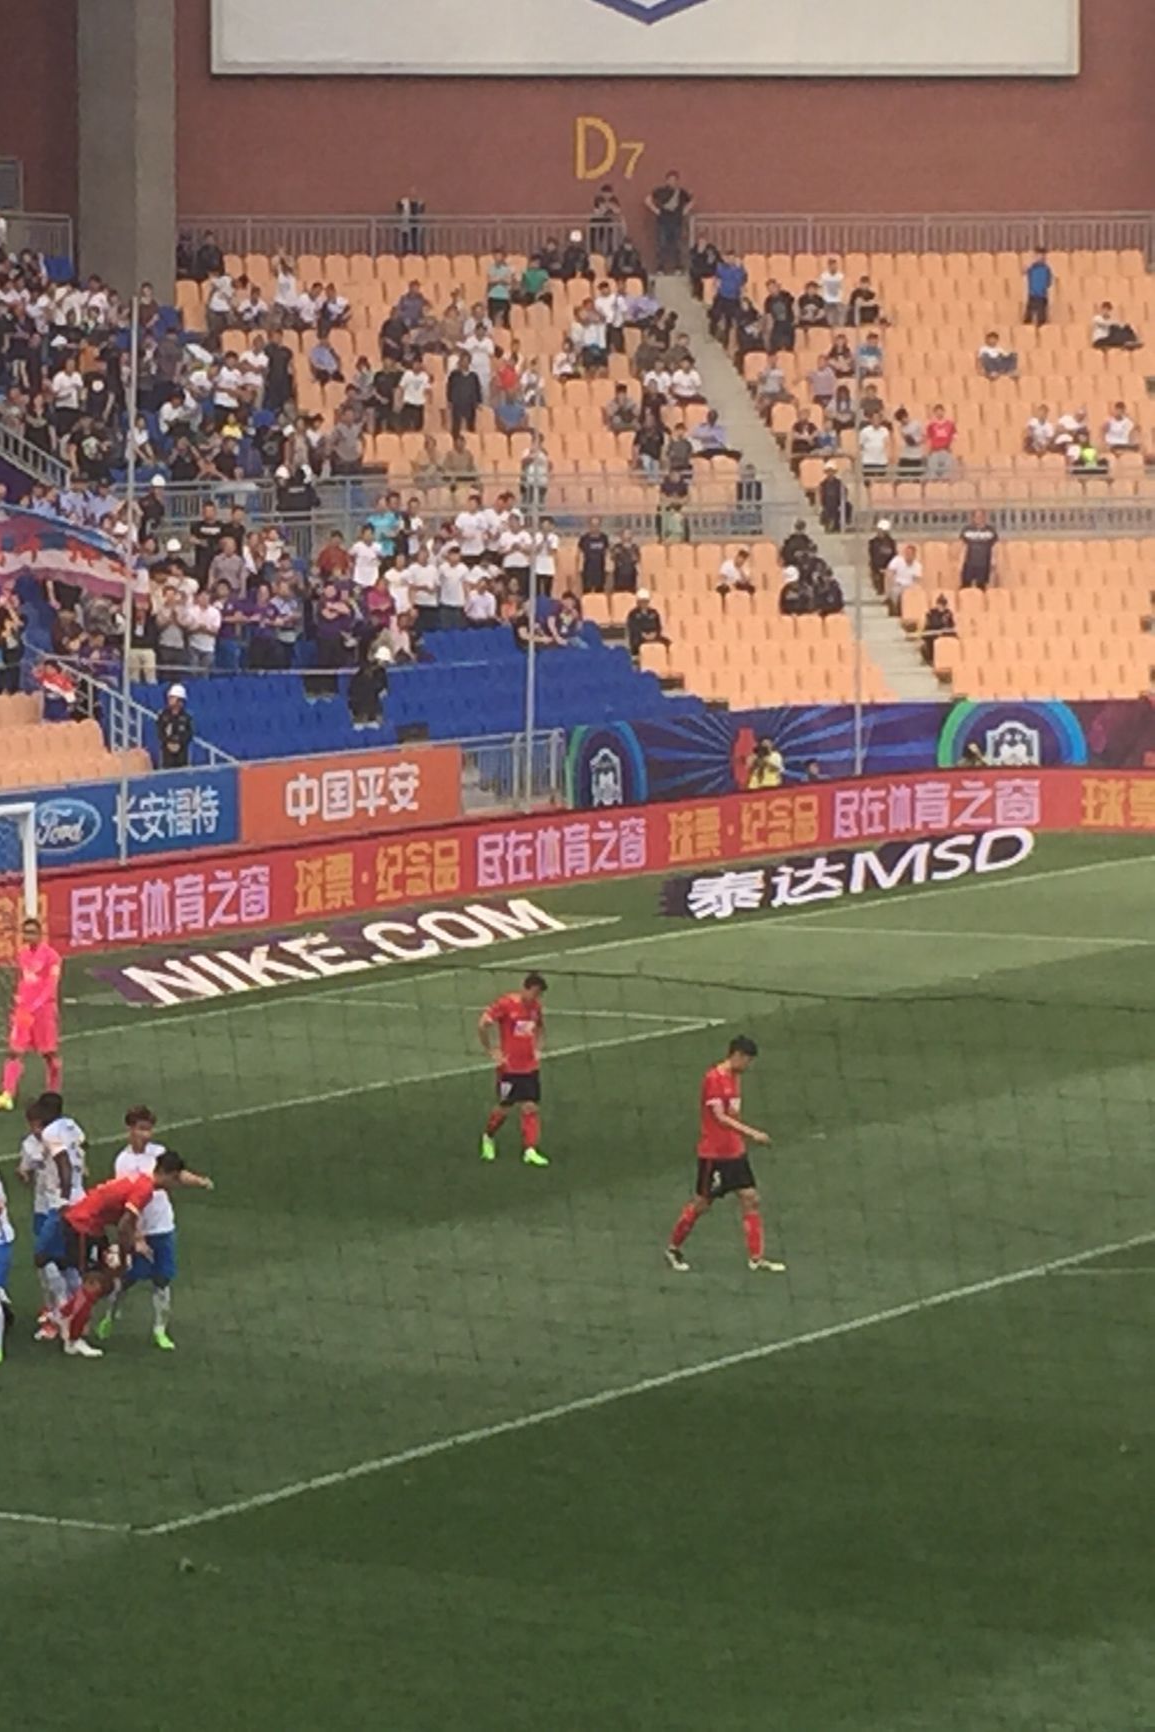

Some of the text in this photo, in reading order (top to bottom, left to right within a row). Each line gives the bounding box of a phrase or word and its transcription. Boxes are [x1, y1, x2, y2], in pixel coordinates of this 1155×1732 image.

[575, 116, 645, 180] D7
[112, 785, 220, 846] 长安福特
[285, 762, 421, 826] 中国平安
[833, 778, 1040, 839] 尽在体育之窗
[36, 808, 86, 845] Ford
[477, 816, 646, 888] 尽在体育之窗
[687, 827, 1035, 919] 泰达MSD
[70, 865, 271, 947] 尽在体育之窗
[122, 899, 566, 1006] NIKE.COM
